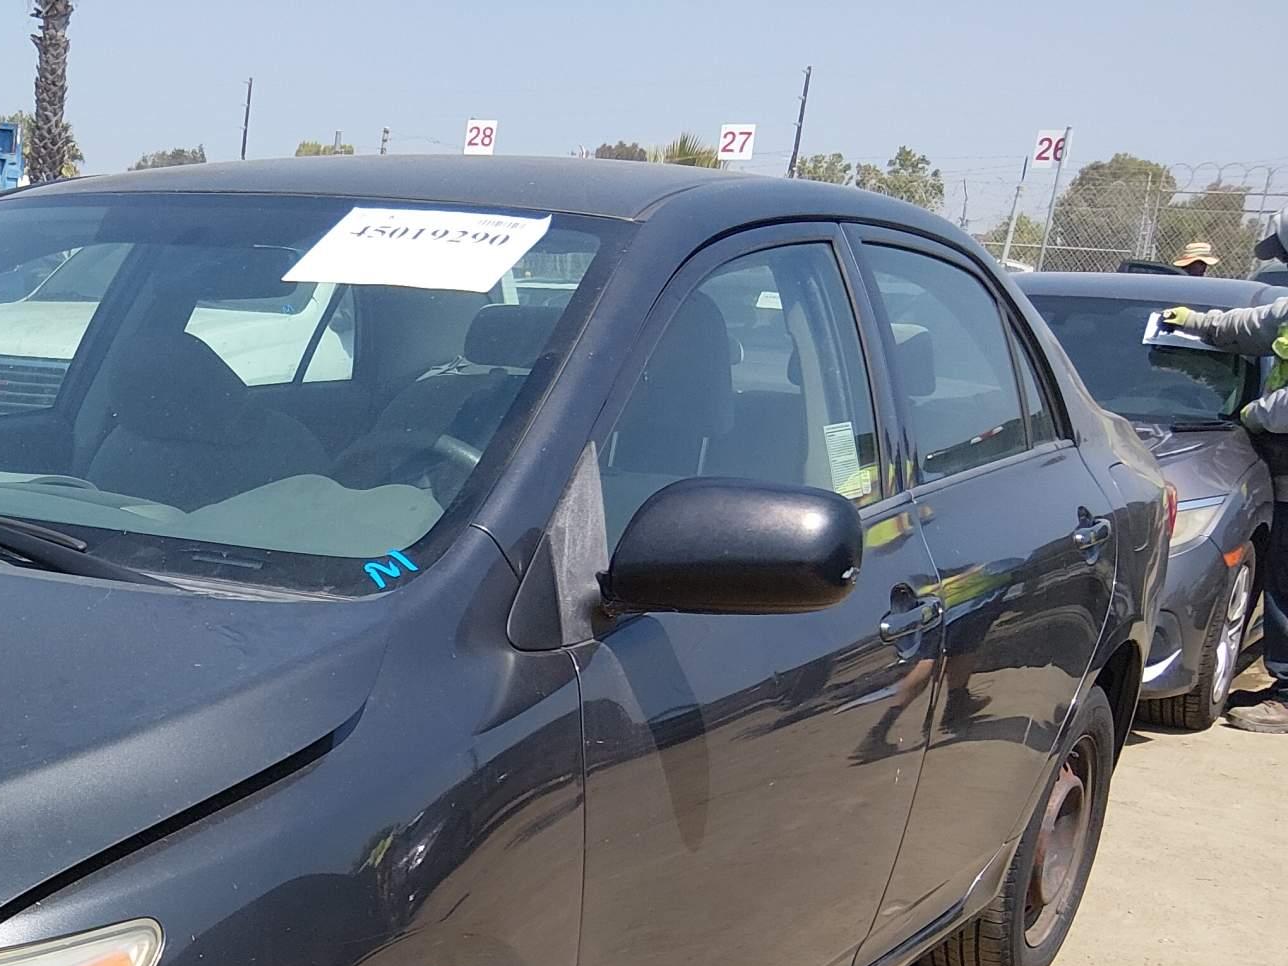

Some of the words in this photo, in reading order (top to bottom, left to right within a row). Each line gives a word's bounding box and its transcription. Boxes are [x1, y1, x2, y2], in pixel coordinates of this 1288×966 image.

[467, 126, 494, 147] 28
[720, 131, 753, 153] 27
[349, 225, 511, 247] 45019290
